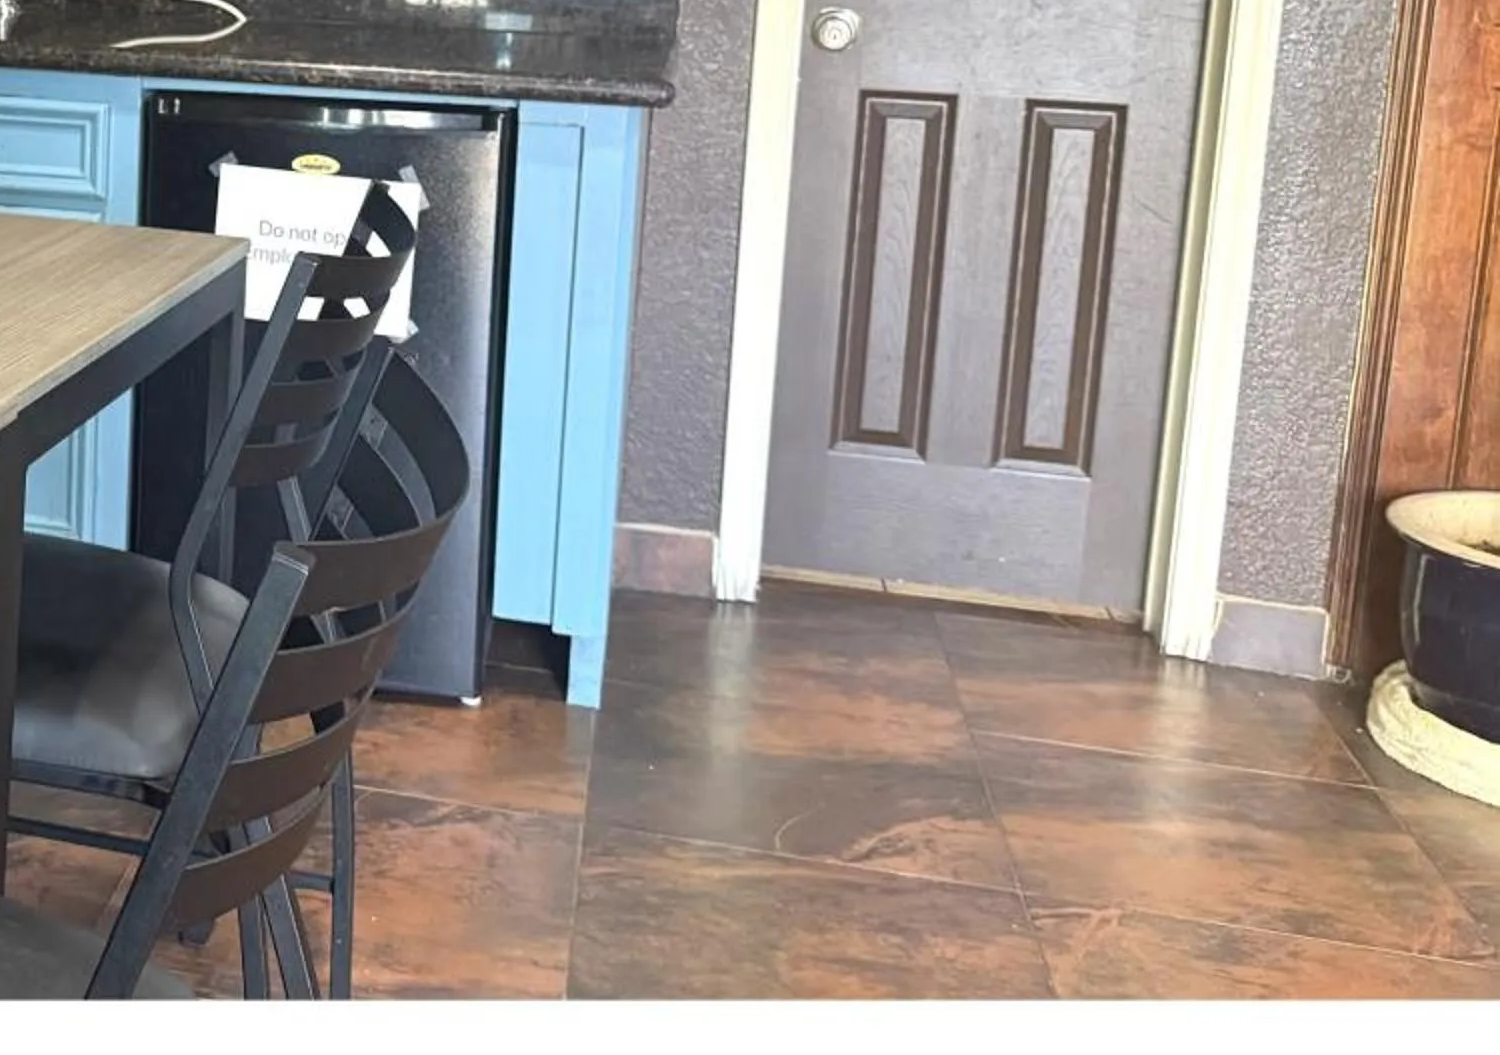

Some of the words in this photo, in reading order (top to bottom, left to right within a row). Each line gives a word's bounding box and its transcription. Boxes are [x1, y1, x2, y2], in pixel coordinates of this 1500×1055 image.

[259, 220, 284, 238] Do
[288, 227, 317, 242] not
[323, 232, 347, 250] op
